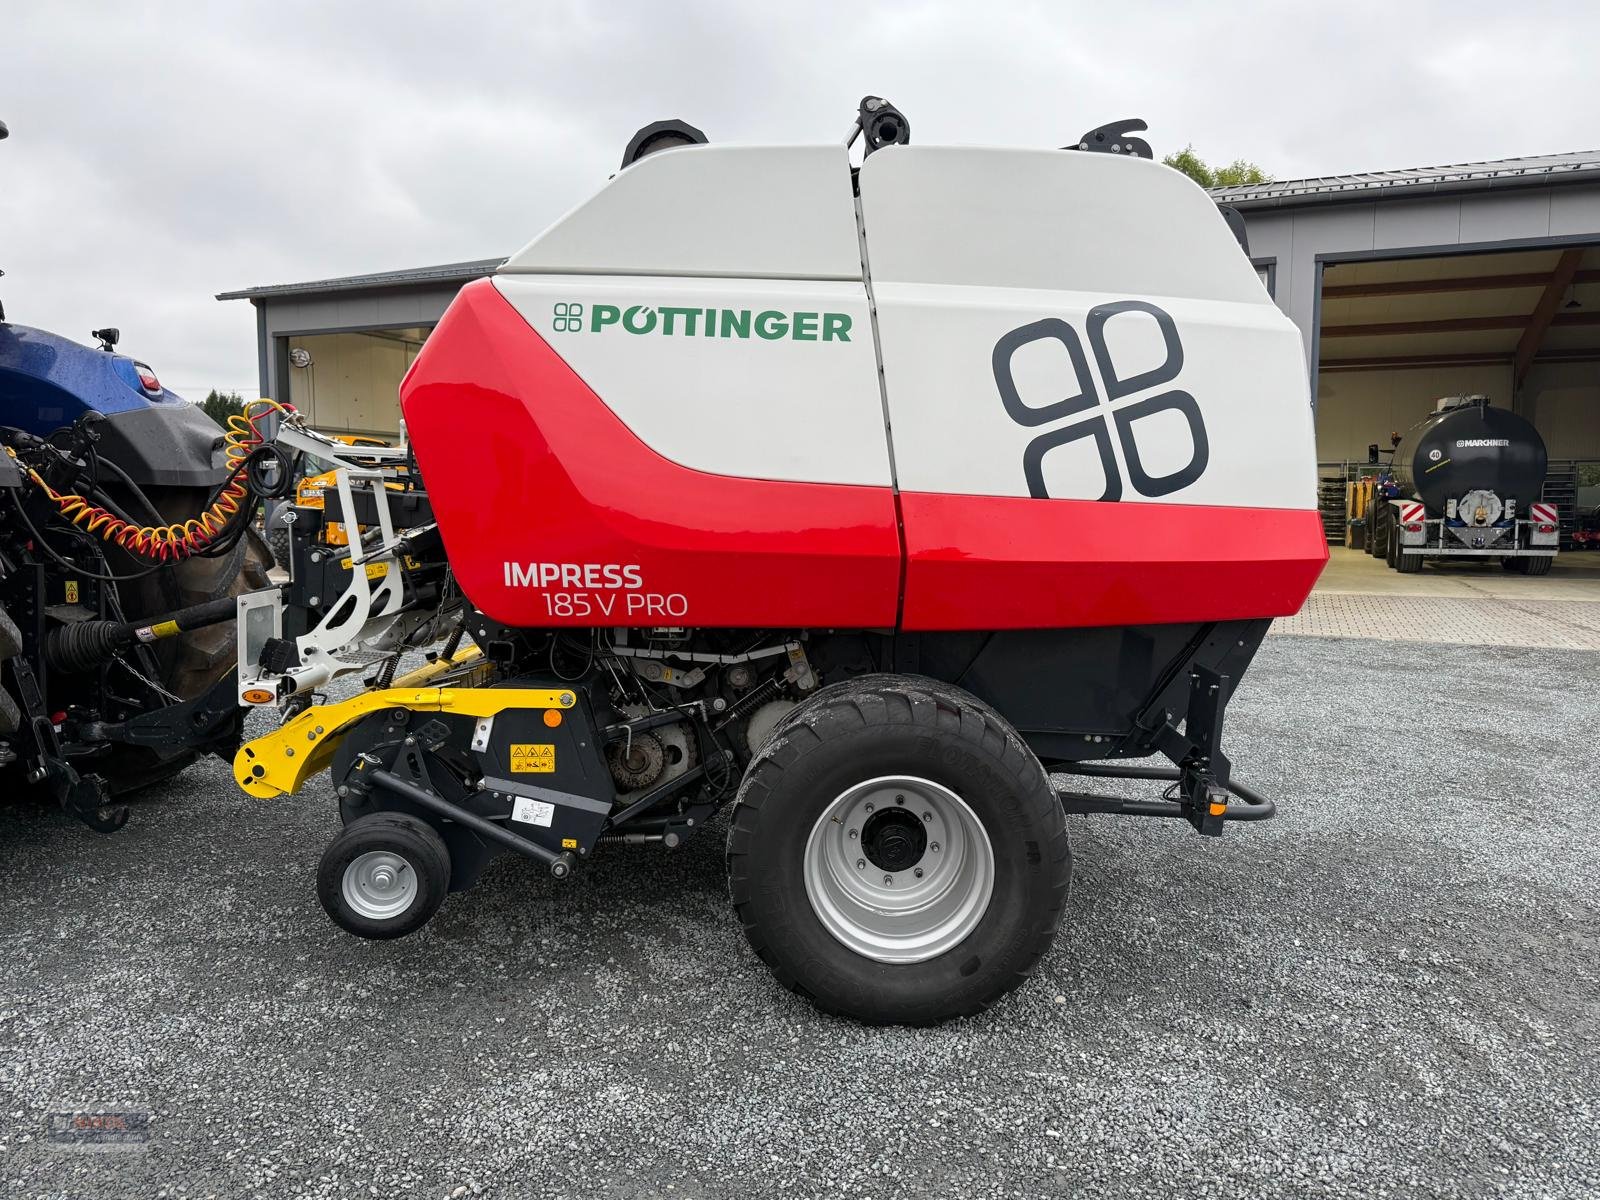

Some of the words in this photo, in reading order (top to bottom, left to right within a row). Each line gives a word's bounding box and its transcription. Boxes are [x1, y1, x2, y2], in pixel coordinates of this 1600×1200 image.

[503, 562, 643, 589] IMPRESS
[542, 592, 591, 617] 185
[594, 593, 616, 616] V
[626, 593, 688, 617] PRO
